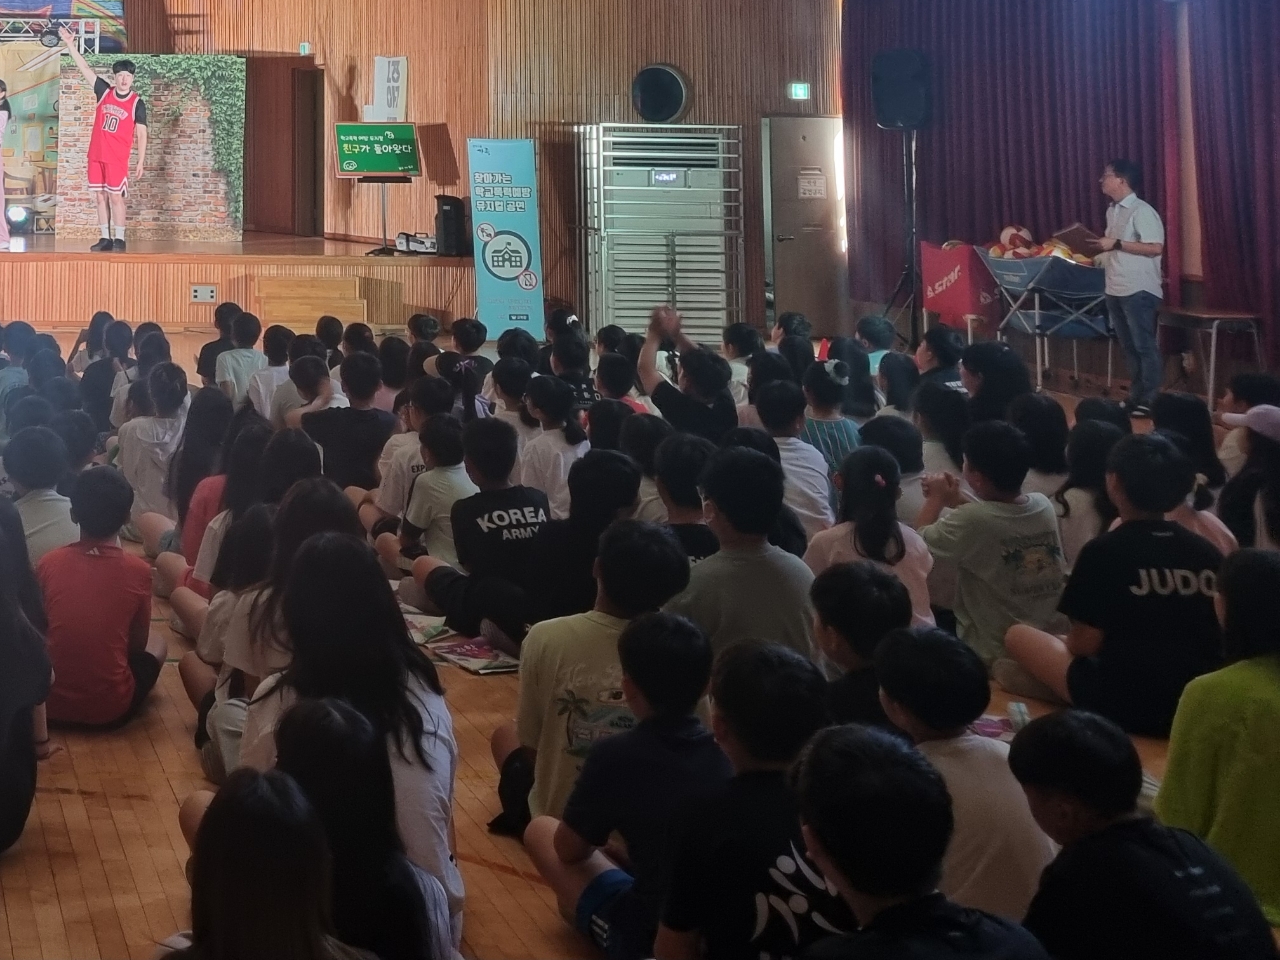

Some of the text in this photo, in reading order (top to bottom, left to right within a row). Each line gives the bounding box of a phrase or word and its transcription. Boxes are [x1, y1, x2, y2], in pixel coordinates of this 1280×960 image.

[102, 114, 119, 133] 10
[343, 144, 412, 154] 친구가 돌아왔다
[474, 172, 512, 184] 찾아가는
[474, 186, 532, 198] 학교폭력예방
[476, 200, 525, 212] 뮤지컬 공연
[476, 506, 547, 533] KOREA
[502, 525, 539, 541] ARMY
[1128, 568, 1219, 597] JUDO
